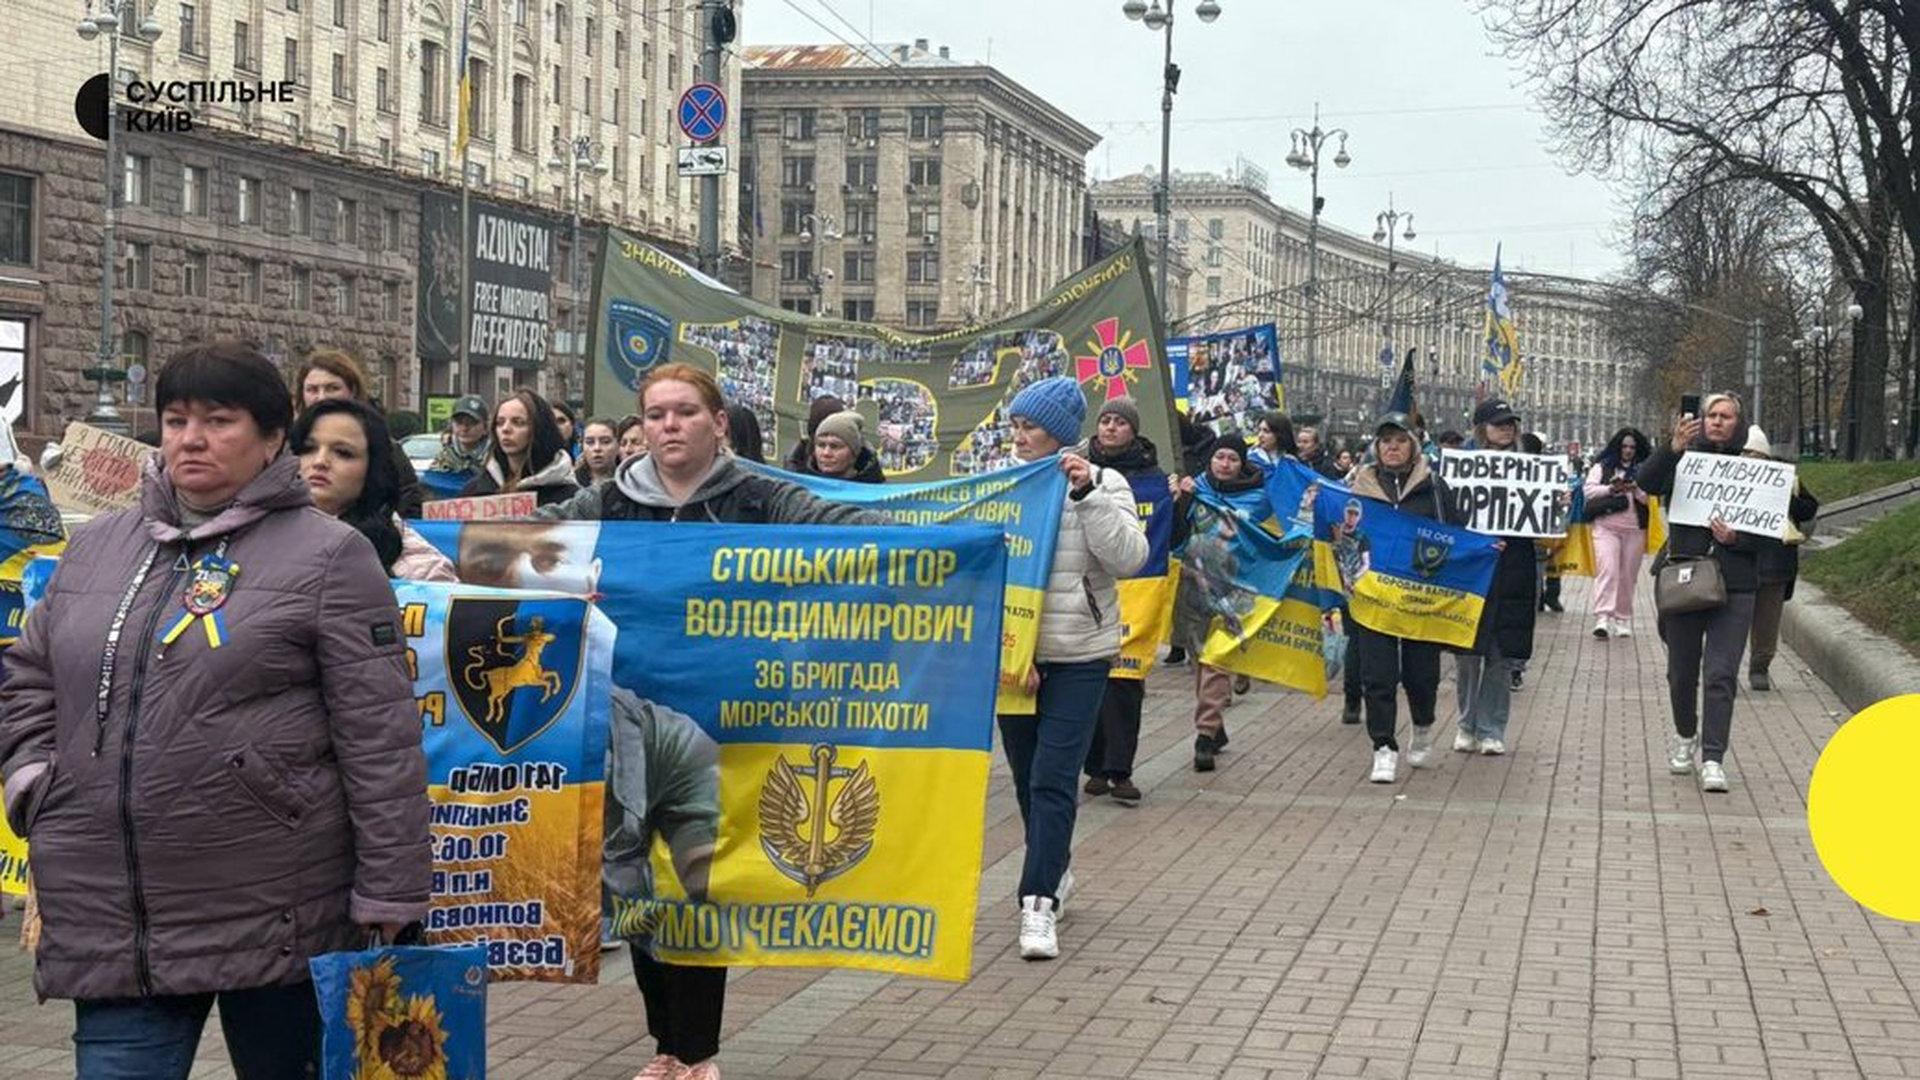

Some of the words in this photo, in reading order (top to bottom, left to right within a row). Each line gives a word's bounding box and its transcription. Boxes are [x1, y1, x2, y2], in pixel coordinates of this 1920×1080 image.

[473, 280, 500, 313] FREE
[470, 313, 548, 361] DEFENDERS
[1682, 458, 1707, 475] НЕ
[1709, 460, 1786, 488] МОВЧІТЬ
[1687, 481, 1754, 505] ПОЛОН
[711, 543, 878, 586] СТОЦЬКИЙ
[887, 548, 957, 587] ІГОР
[685, 597, 974, 643] ВОЛОДИМИРОВИЧ
[755, 660, 785, 690] 36
[791, 661, 901, 692] БРИГАДА
[720, 698, 838, 729] МОРСЬКОЇ
[846, 701, 930, 731] ПІХОТИ
[730, 905, 740, 949] І
[748, 904, 932, 957] ЧЕКАЄМО!
